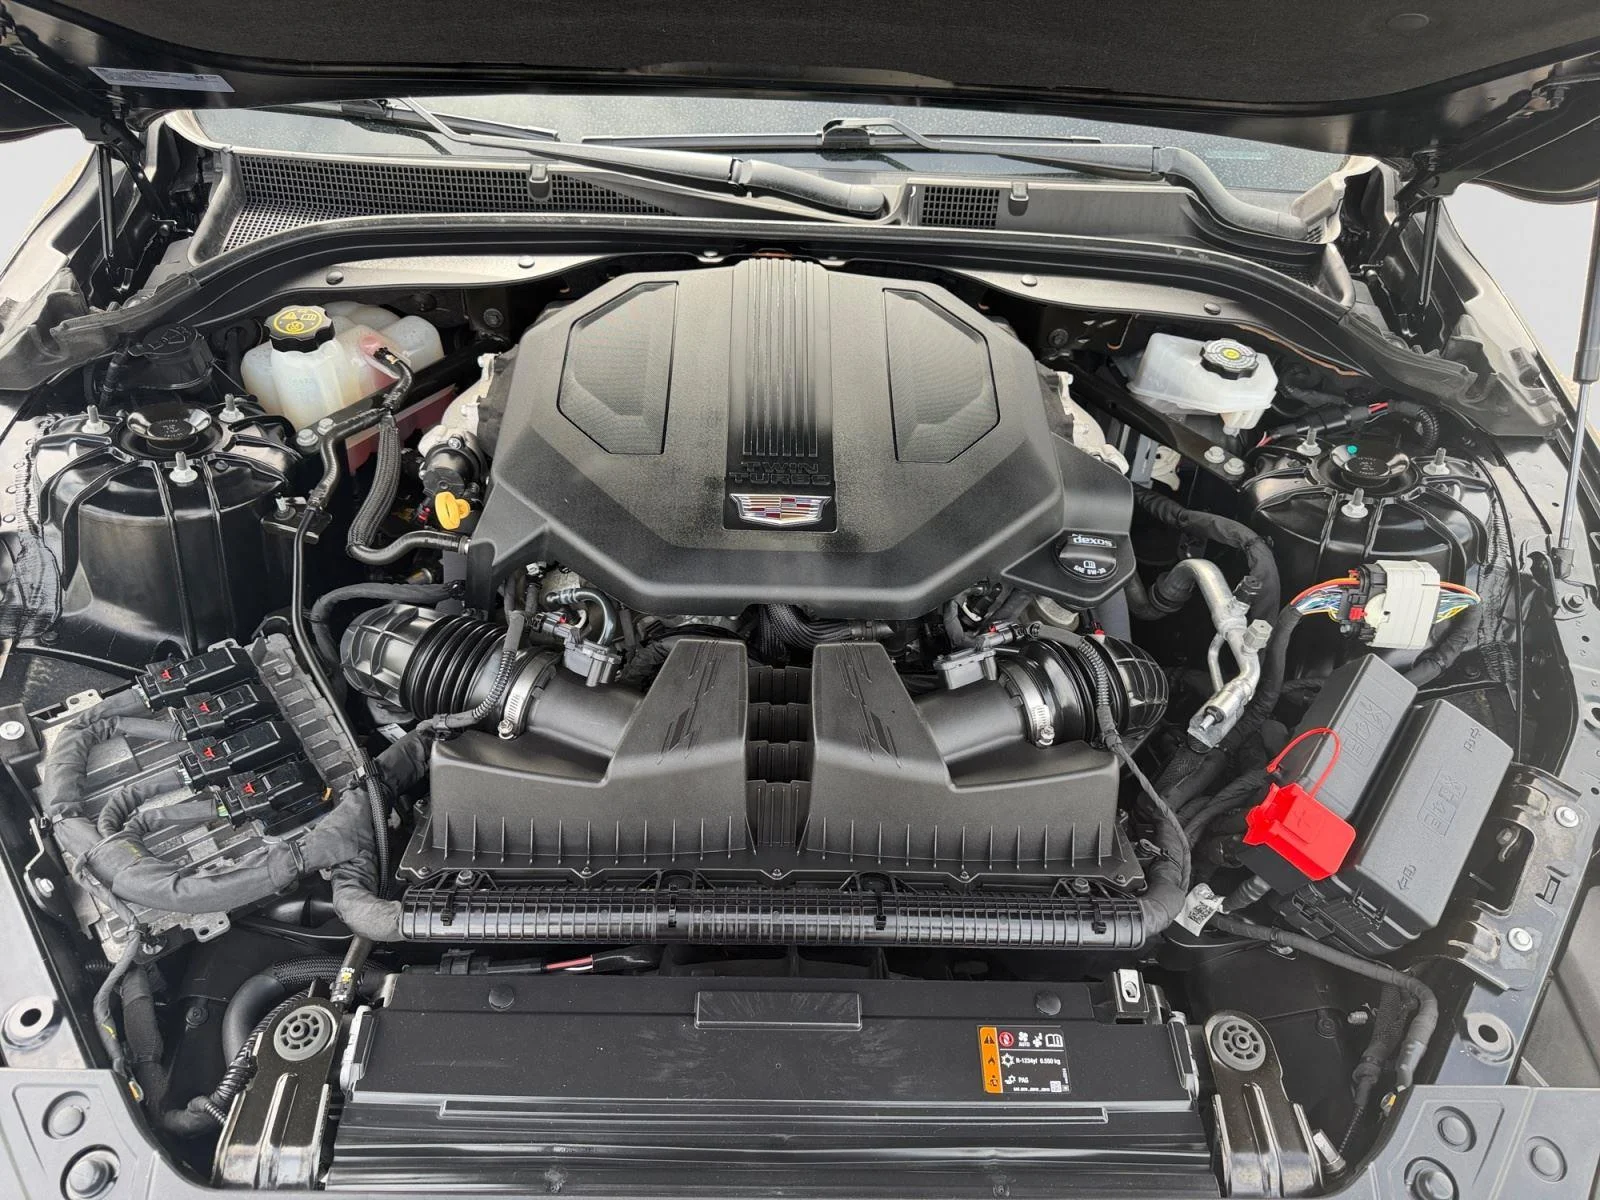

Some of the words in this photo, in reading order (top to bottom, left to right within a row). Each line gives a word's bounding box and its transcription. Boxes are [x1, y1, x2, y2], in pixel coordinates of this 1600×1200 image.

[741, 461, 819, 473] TWIN
[729, 472, 831, 485] TURBO
[1073, 535, 1112, 547] dexos
